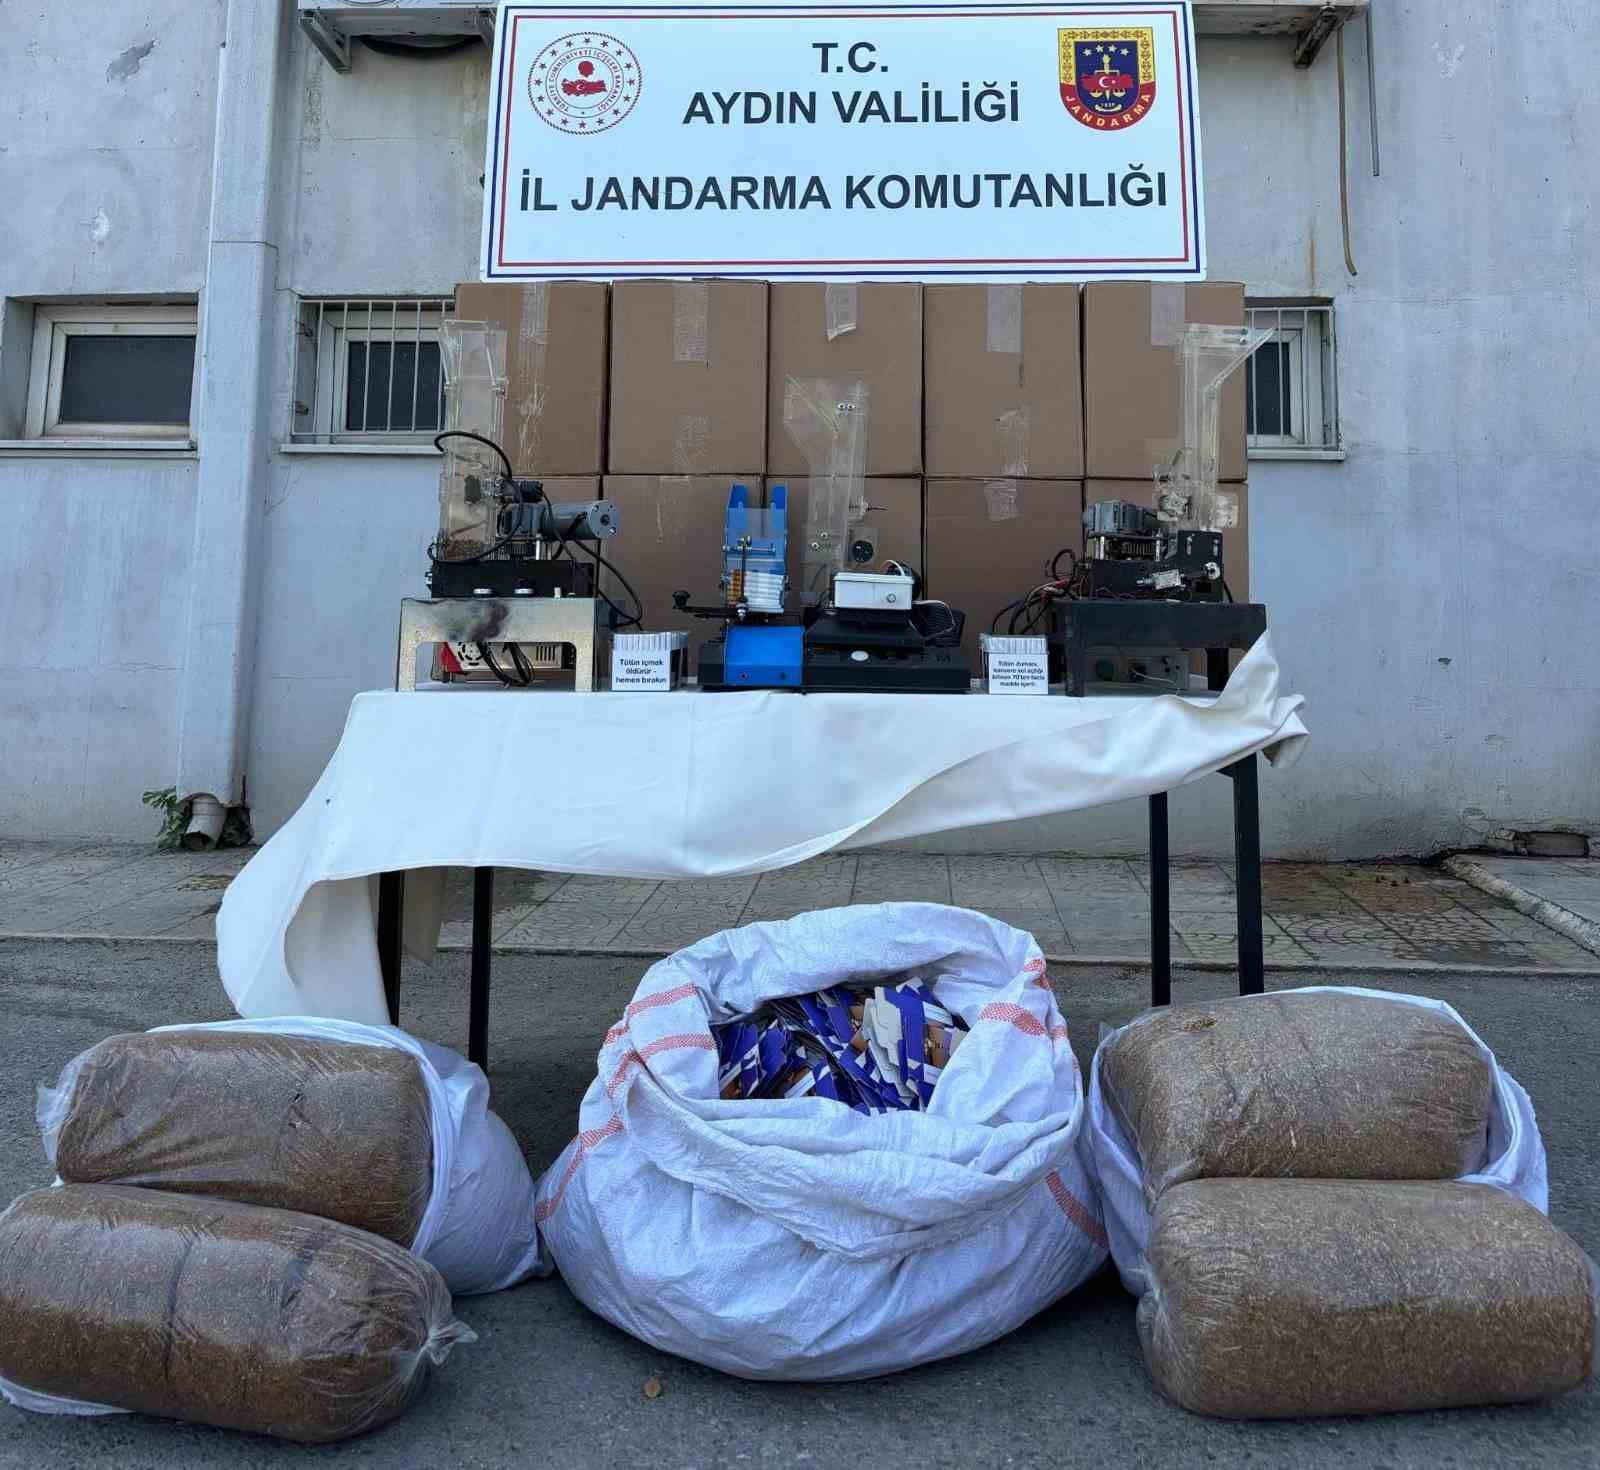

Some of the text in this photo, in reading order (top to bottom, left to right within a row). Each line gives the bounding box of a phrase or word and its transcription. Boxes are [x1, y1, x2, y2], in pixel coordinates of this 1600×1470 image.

[812, 41, 889, 73] T.C.
[682, 80, 1019, 125] AYDIN VALİLİĞİ
[1066, 94, 1151, 127] JANDARMA
[520, 163, 1167, 212] İL JANDARMA KOMUTANLIĞI
[620, 658, 640, 666] Tütün
[615, 676, 640, 684] hemen
